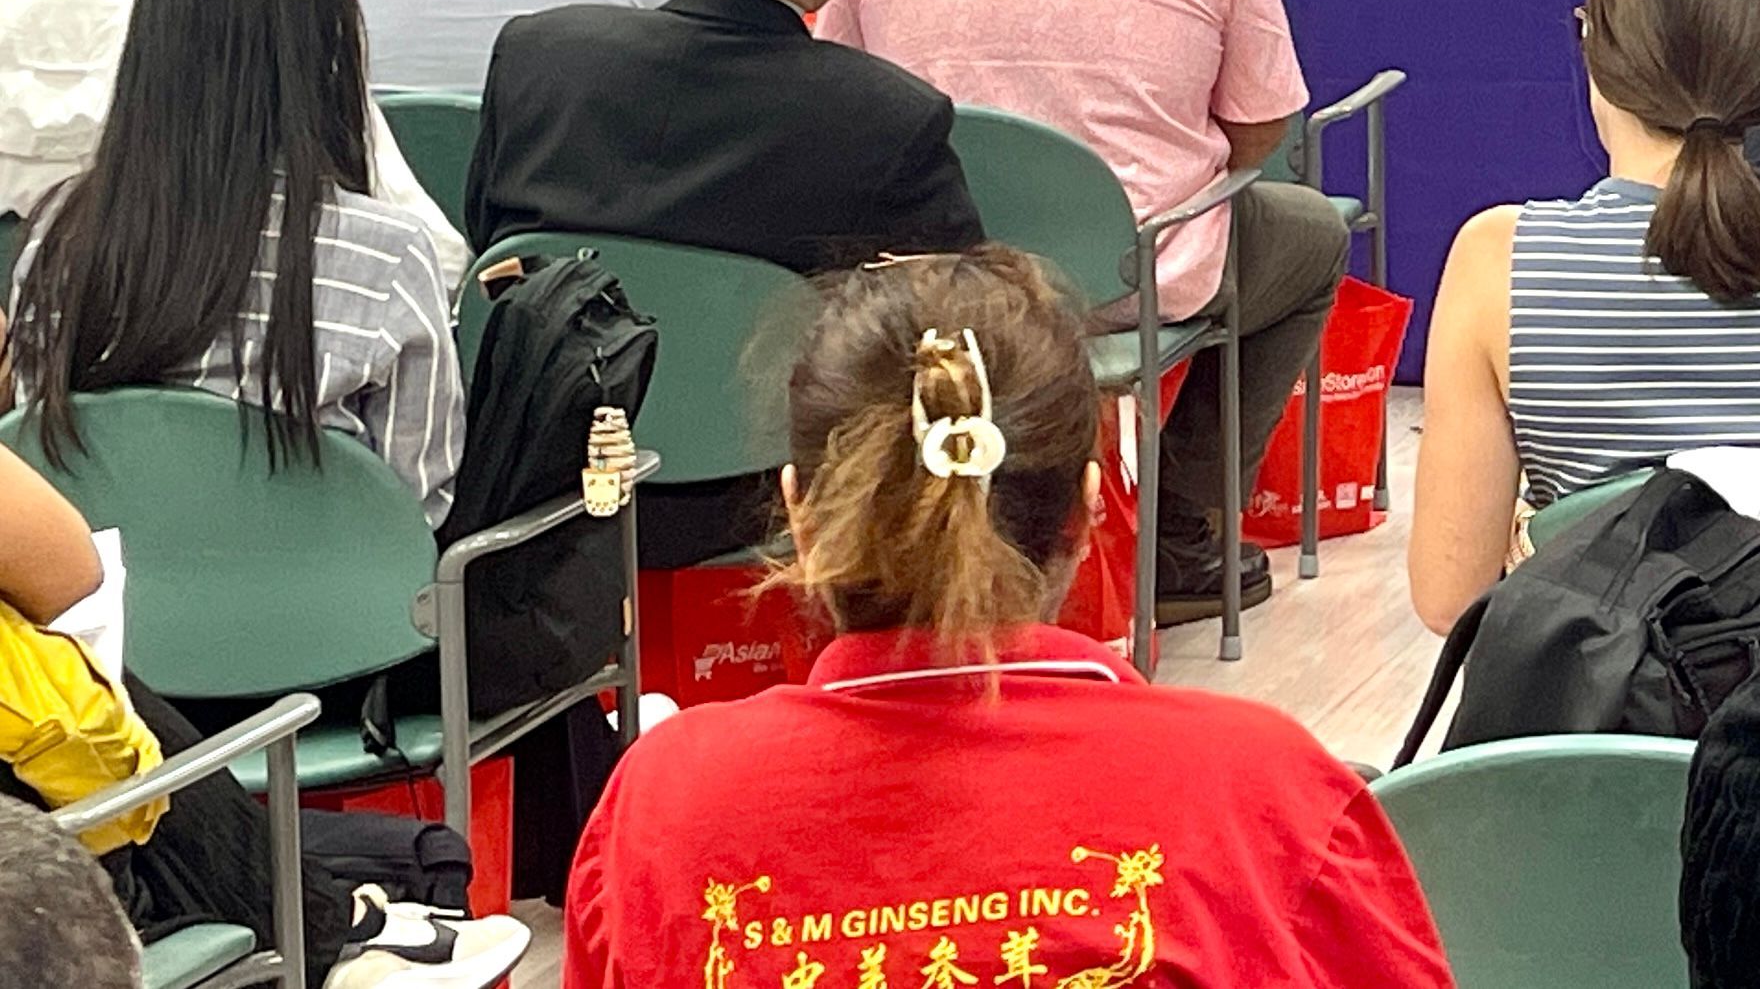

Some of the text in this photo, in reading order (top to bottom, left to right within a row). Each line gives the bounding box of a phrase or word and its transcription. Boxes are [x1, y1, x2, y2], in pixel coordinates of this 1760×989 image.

[743, 888, 1100, 950] S & M GINSENG INC.
